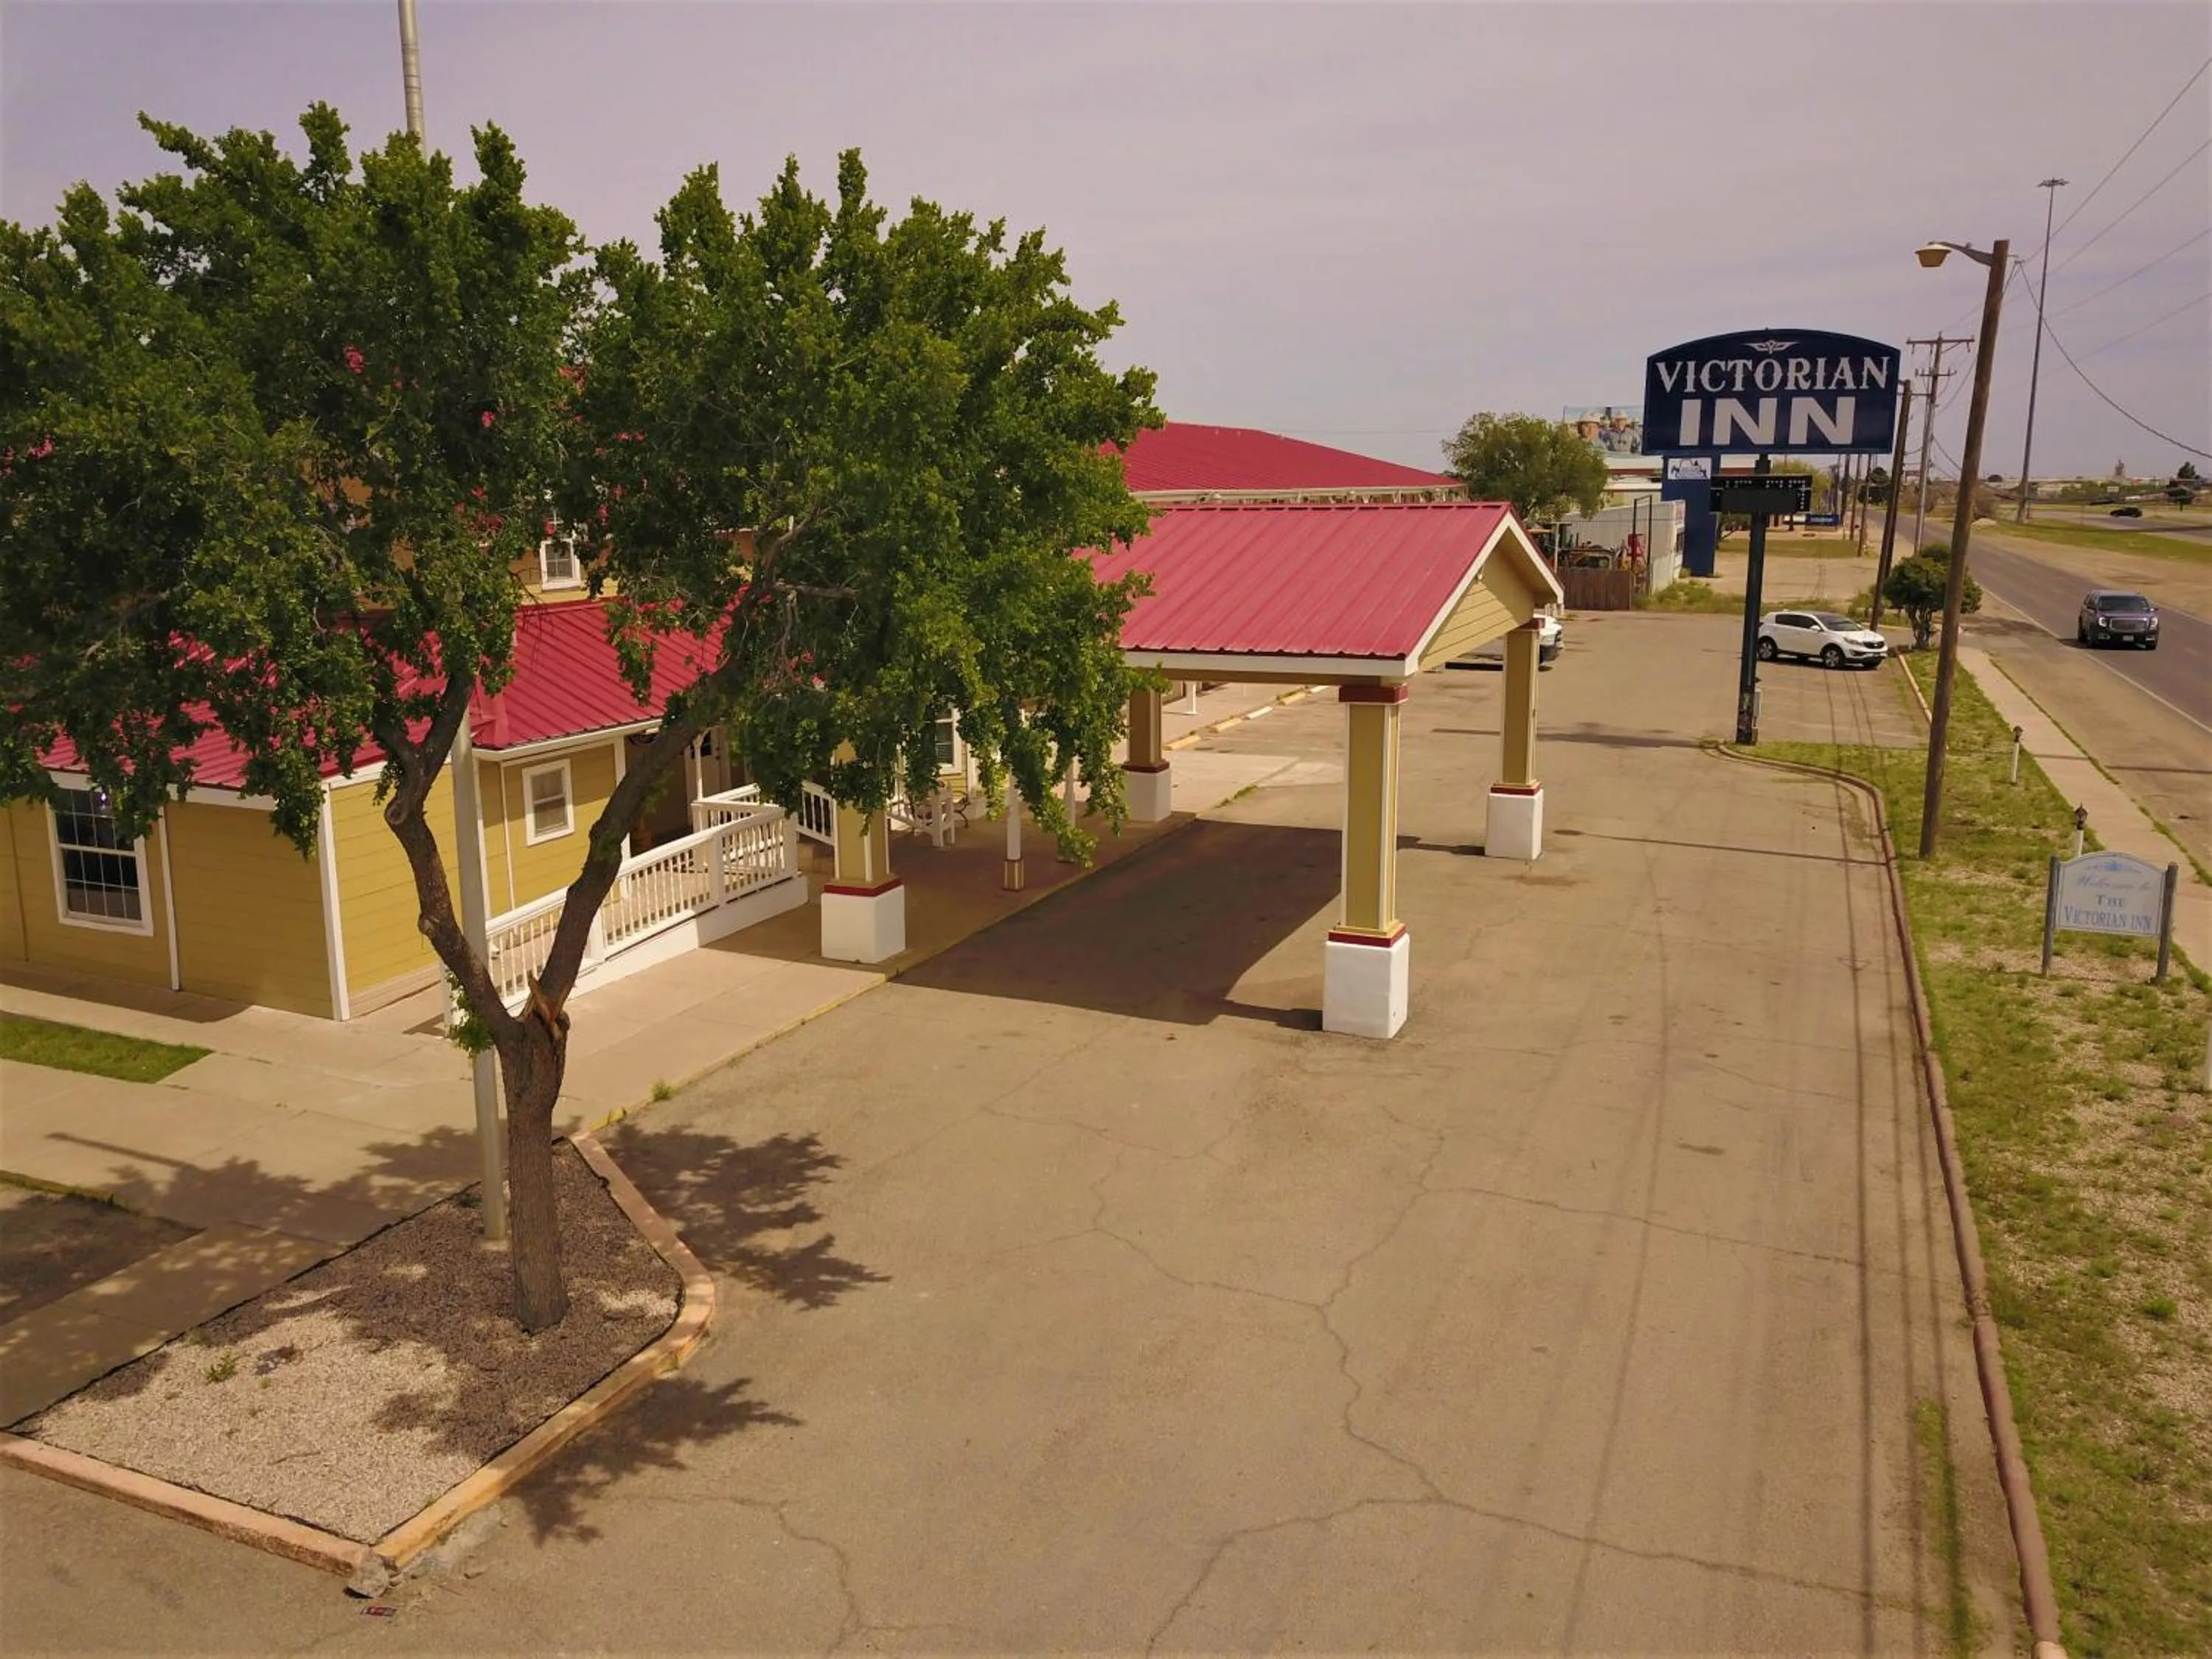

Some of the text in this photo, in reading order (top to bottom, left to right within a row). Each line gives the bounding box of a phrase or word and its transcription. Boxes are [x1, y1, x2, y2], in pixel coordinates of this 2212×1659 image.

[1657, 357, 1890, 393] VICTORIAN
[1679, 396, 1856, 445] INN
[2065, 905, 2152, 931] VICTORIAN INN
